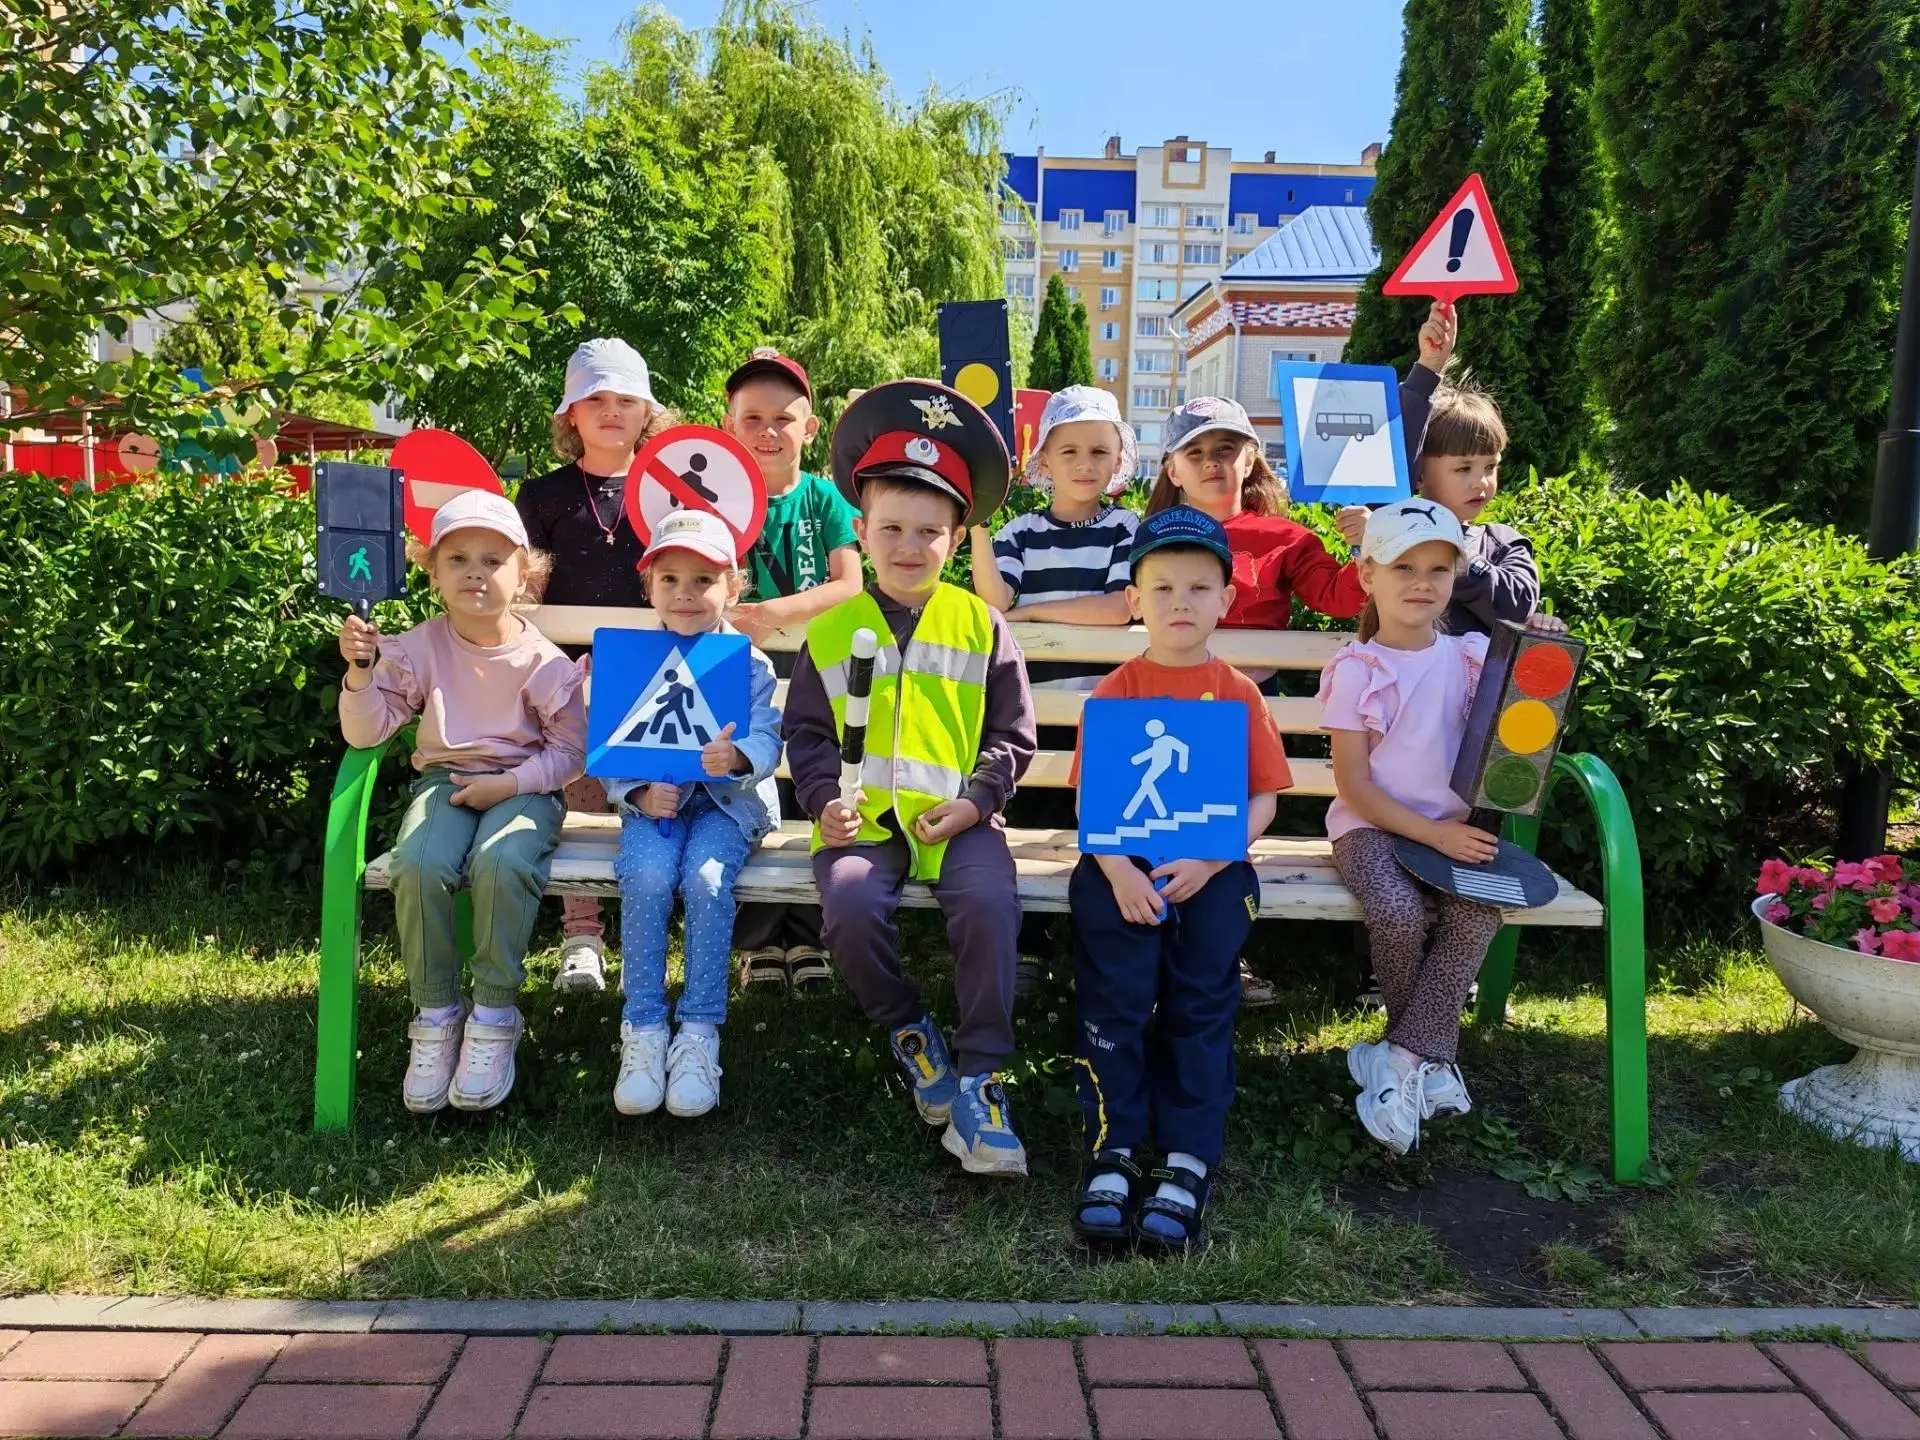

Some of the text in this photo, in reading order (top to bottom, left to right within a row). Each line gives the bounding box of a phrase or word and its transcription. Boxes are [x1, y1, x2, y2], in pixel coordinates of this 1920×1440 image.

[1070, 518, 1094, 529] SURF
[1148, 510, 1216, 533] CREATE
[1098, 1038, 1115, 1051] RIGHT
